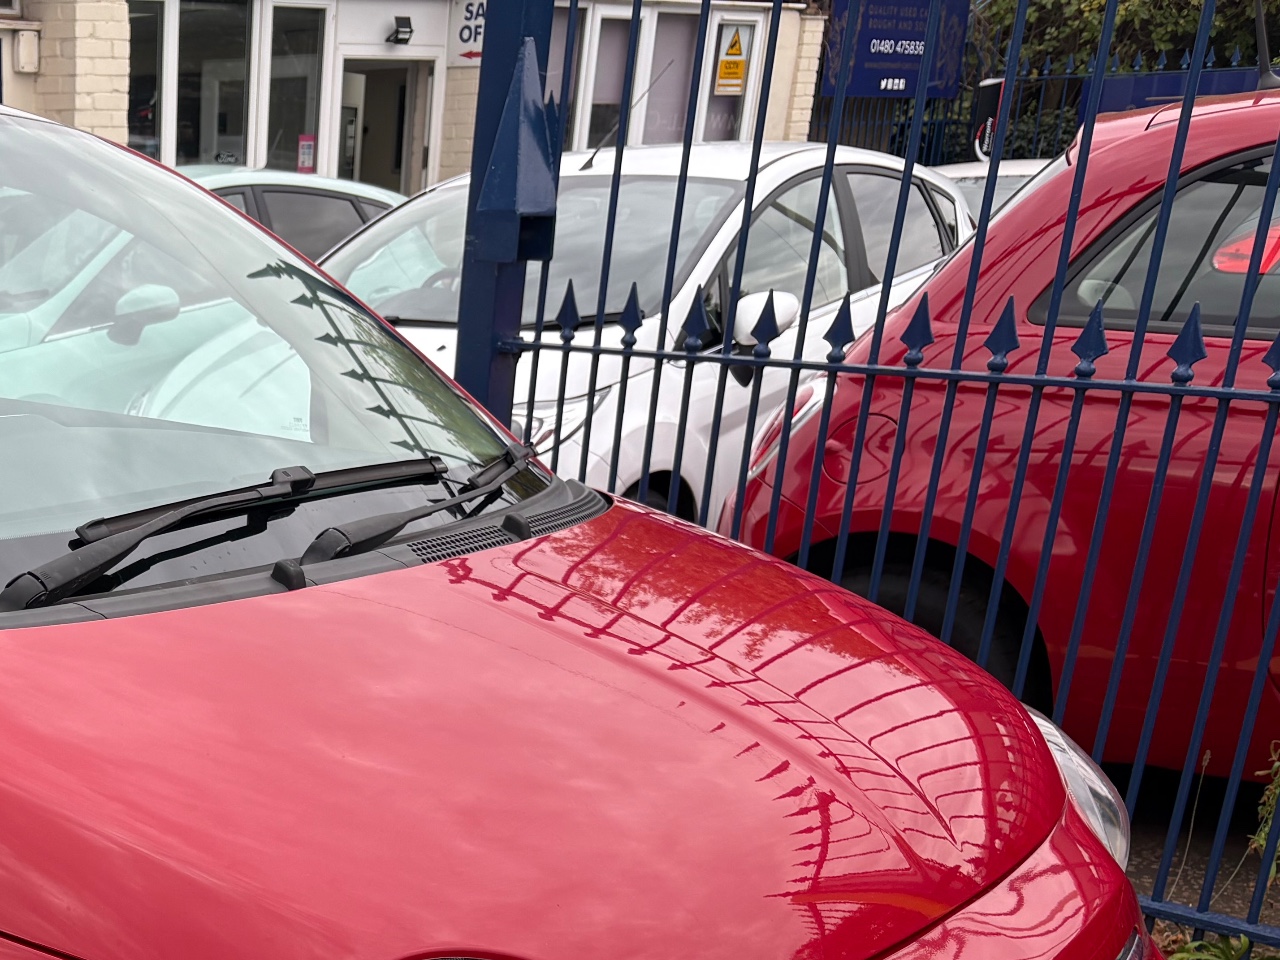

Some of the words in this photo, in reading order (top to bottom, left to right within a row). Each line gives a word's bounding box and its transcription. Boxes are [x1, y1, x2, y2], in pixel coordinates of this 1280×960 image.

[869, 4, 897, 16] QUALITY
[900, 7, 918, 17] USED
[869, 18, 896, 29] BOUGHT
[898, 20, 911, 30] AND
[870, 39, 895, 54] 01480
[895, 41, 925, 55] 475836
